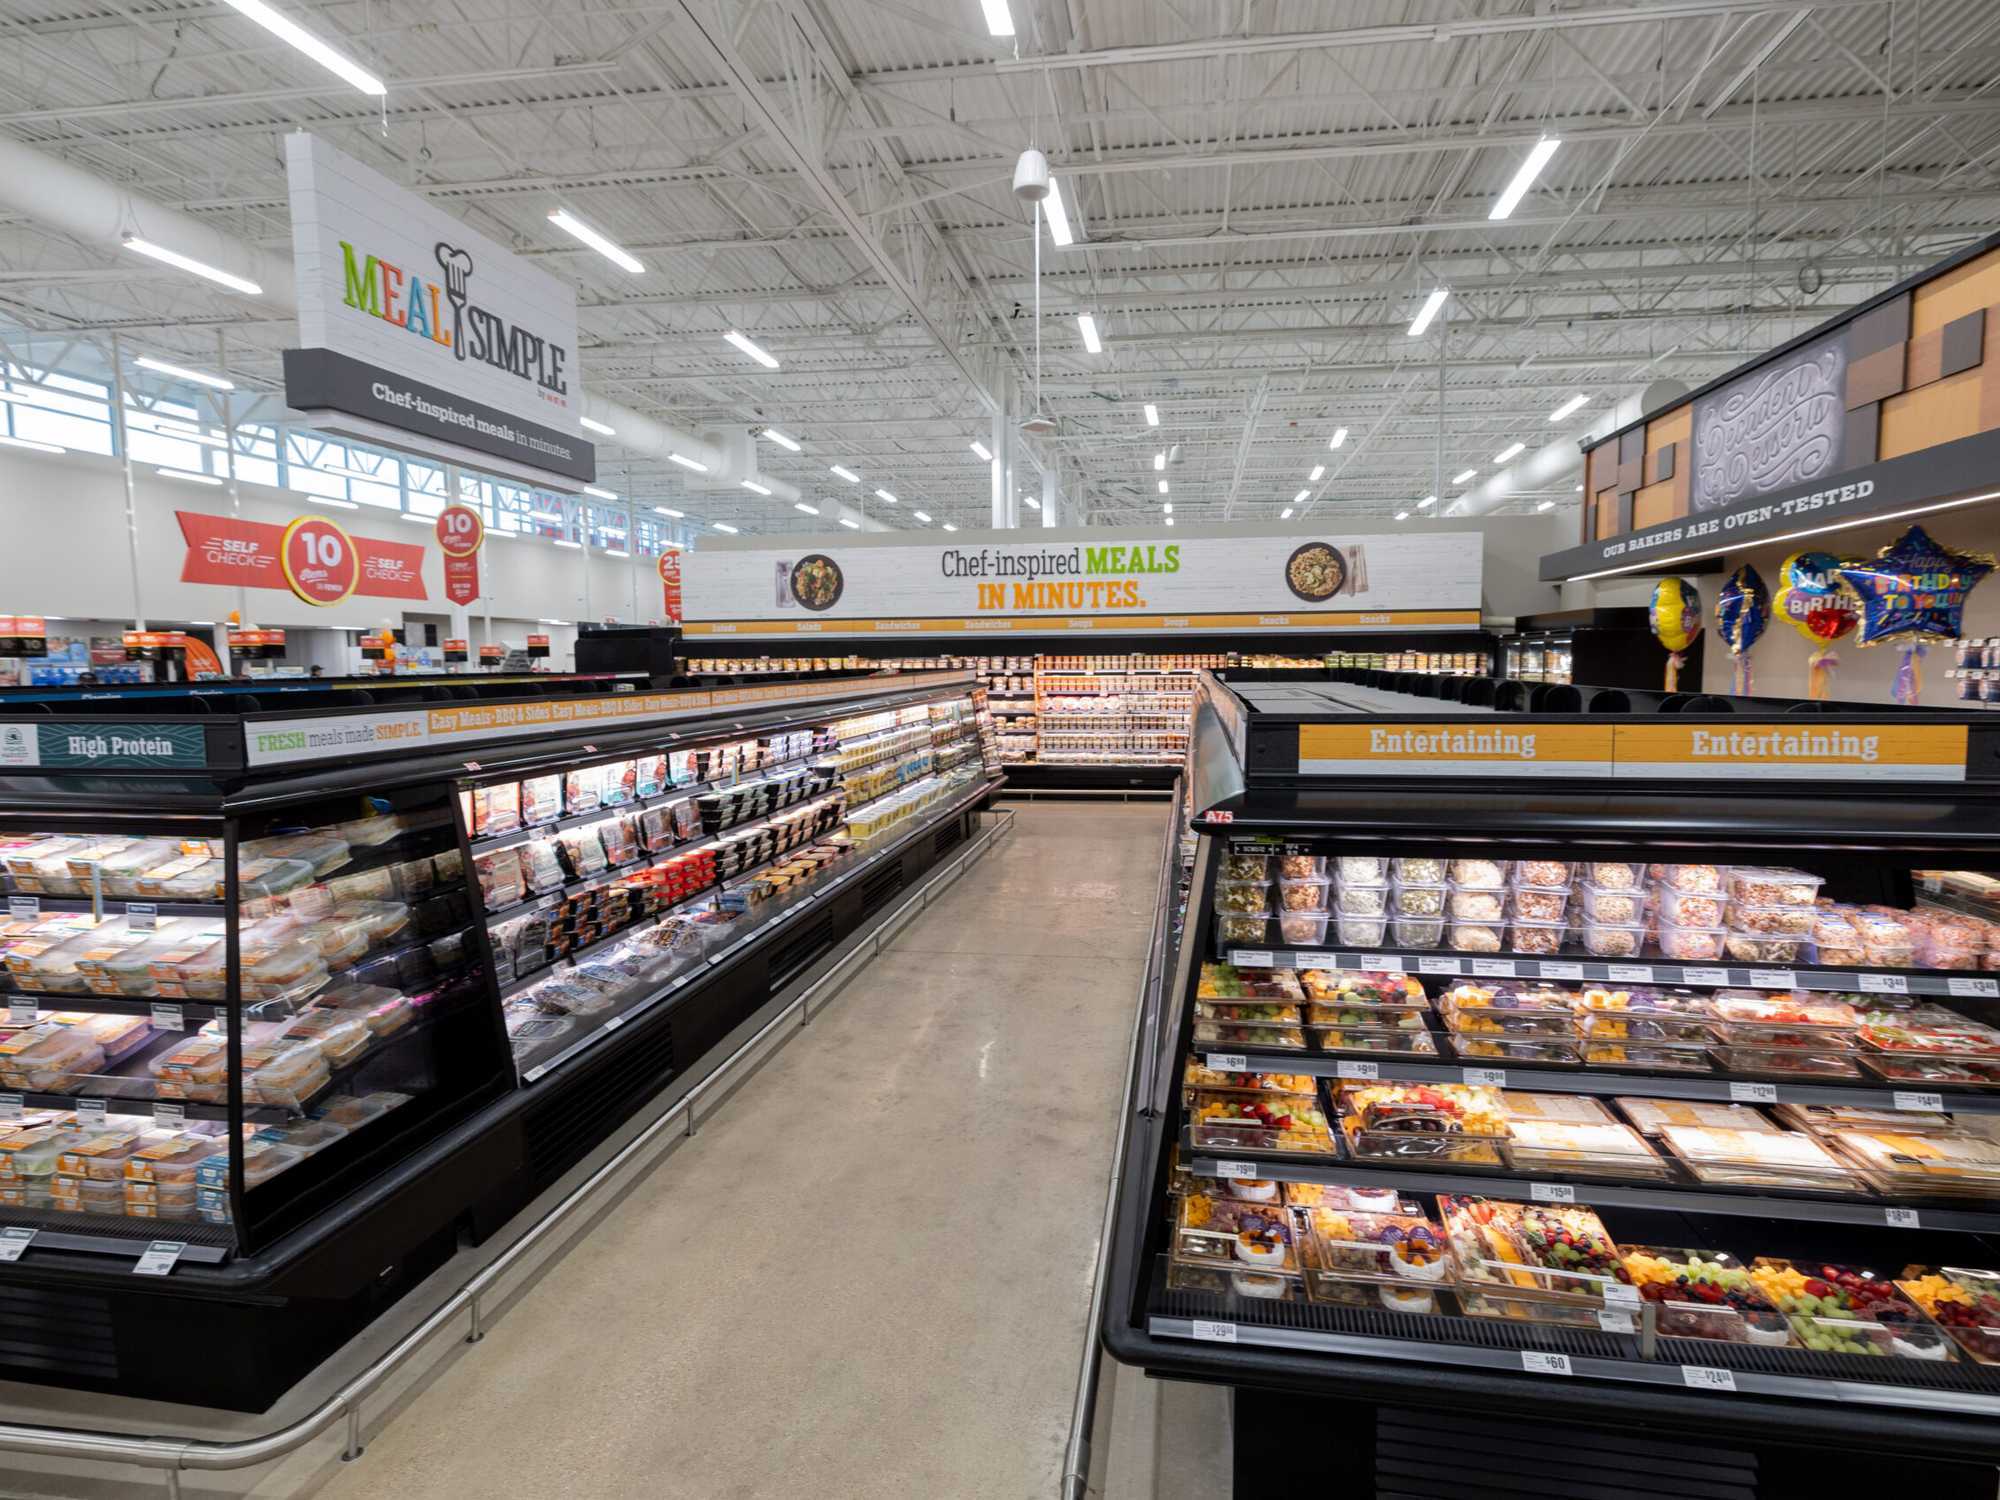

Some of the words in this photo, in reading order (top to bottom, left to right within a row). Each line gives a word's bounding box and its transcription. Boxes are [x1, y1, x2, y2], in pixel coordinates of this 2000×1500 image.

[339, 240, 451, 348] MEAL
[467, 305, 568, 396] SIMPLE
[372, 382, 475, 429] Chef-inspired
[477, 417, 515, 443] meals
[515, 430, 527, 446] in
[444, 513, 472, 533] 10
[1603, 543, 1626, 558] OUR
[1628, 528, 1682, 552] BAKERS
[1686, 519, 1720, 539] ARE
[1723, 480, 1874, 529] OVEN-TESTED
[222, 538, 260, 552] SELF
[301, 532, 342, 567] 10
[206, 550, 257, 567] CHECK
[377, 557, 404, 570] SELF
[942, 548, 1081, 580] Chef-inspired
[1085, 545, 1180, 575] MEALS
[366, 567, 402, 582] CHECK
[1875, 573, 1972, 594] BIRTHDAY
[977, 583, 1007, 610] IN
[1013, 579, 1148, 609] MINUTES.
[1883, 594, 1909, 610] TO
[68, 736, 108, 758] High
[111, 736, 173, 756] Protein
[258, 731, 306, 752] FRESH
[309, 728, 344, 747] meals
[345, 726, 375, 743] made
[1369, 729, 1536, 758] Entertaining
[1691, 730, 1879, 761] Entertaining
[1205, 811, 1233, 823] A75
[1545, 1356, 1565, 1369] $60
